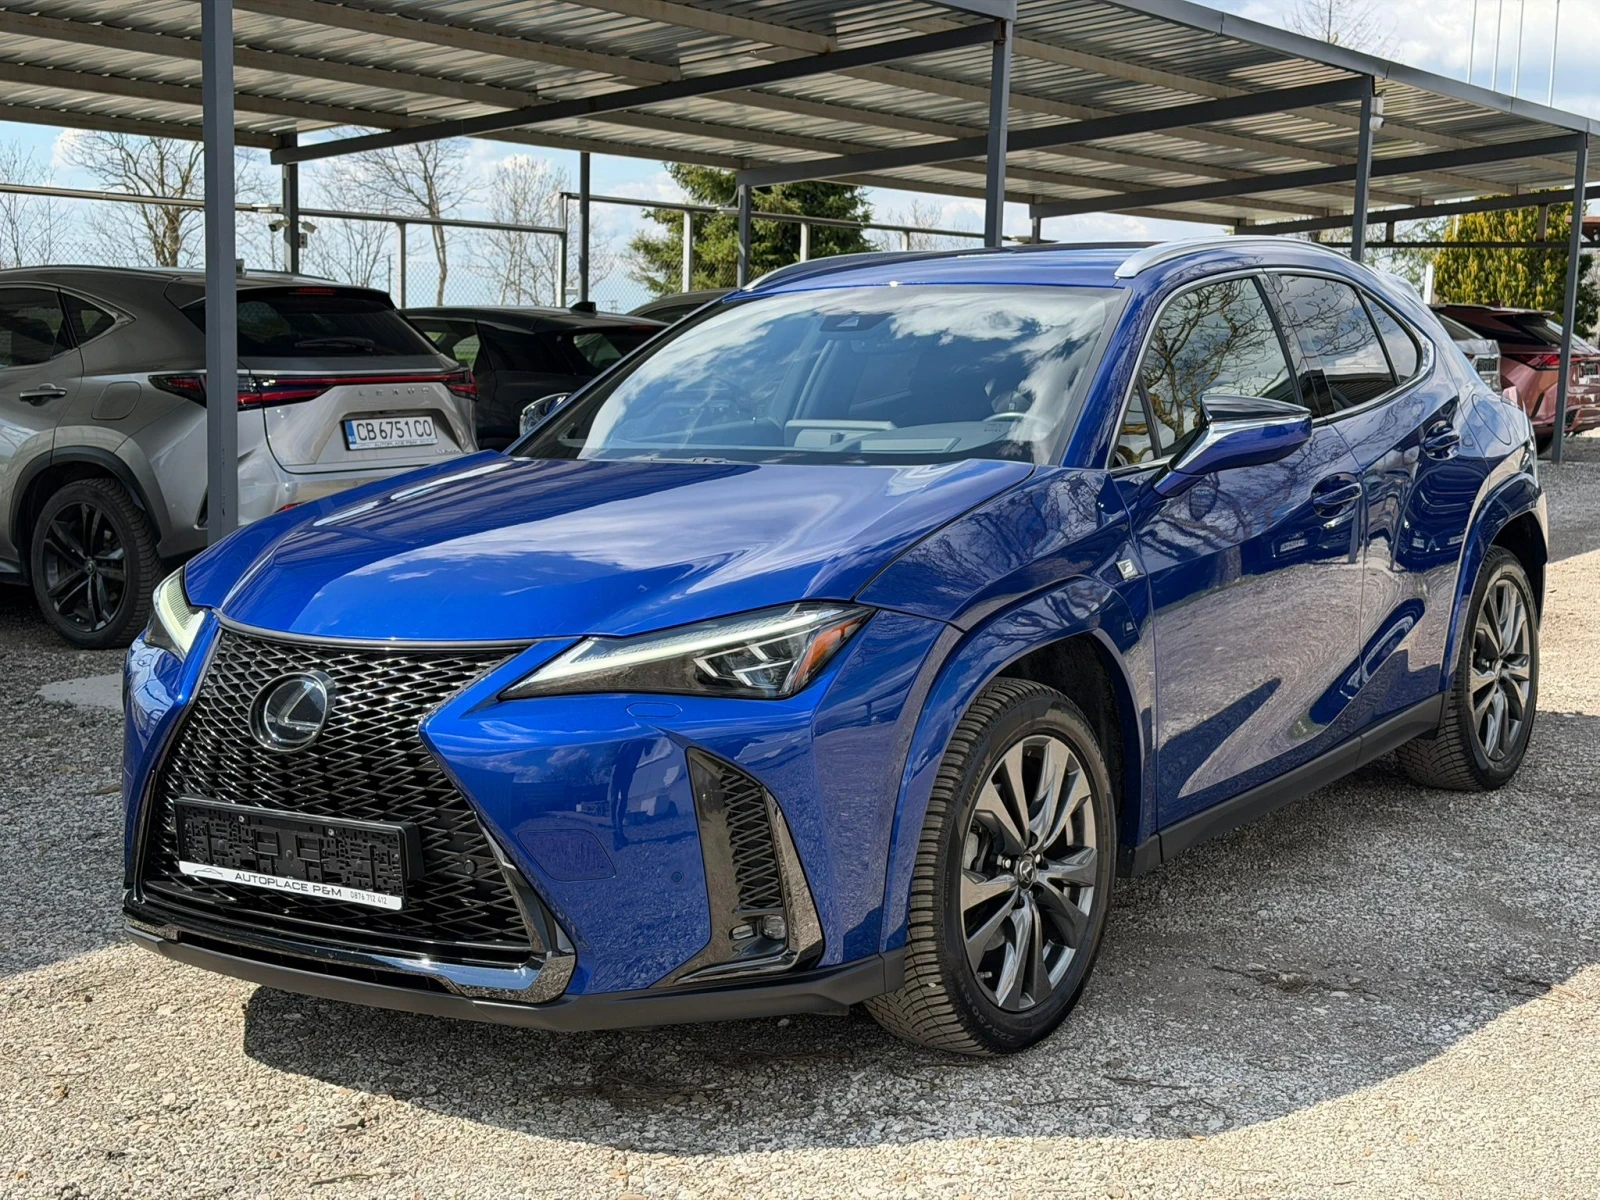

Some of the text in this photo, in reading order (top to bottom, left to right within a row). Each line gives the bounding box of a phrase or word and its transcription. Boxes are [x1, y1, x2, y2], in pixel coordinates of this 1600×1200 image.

[356, 419, 433, 441] CB 6751 CO
[234, 872, 388, 905] AUTOPLACE P&M 0876 712 412
